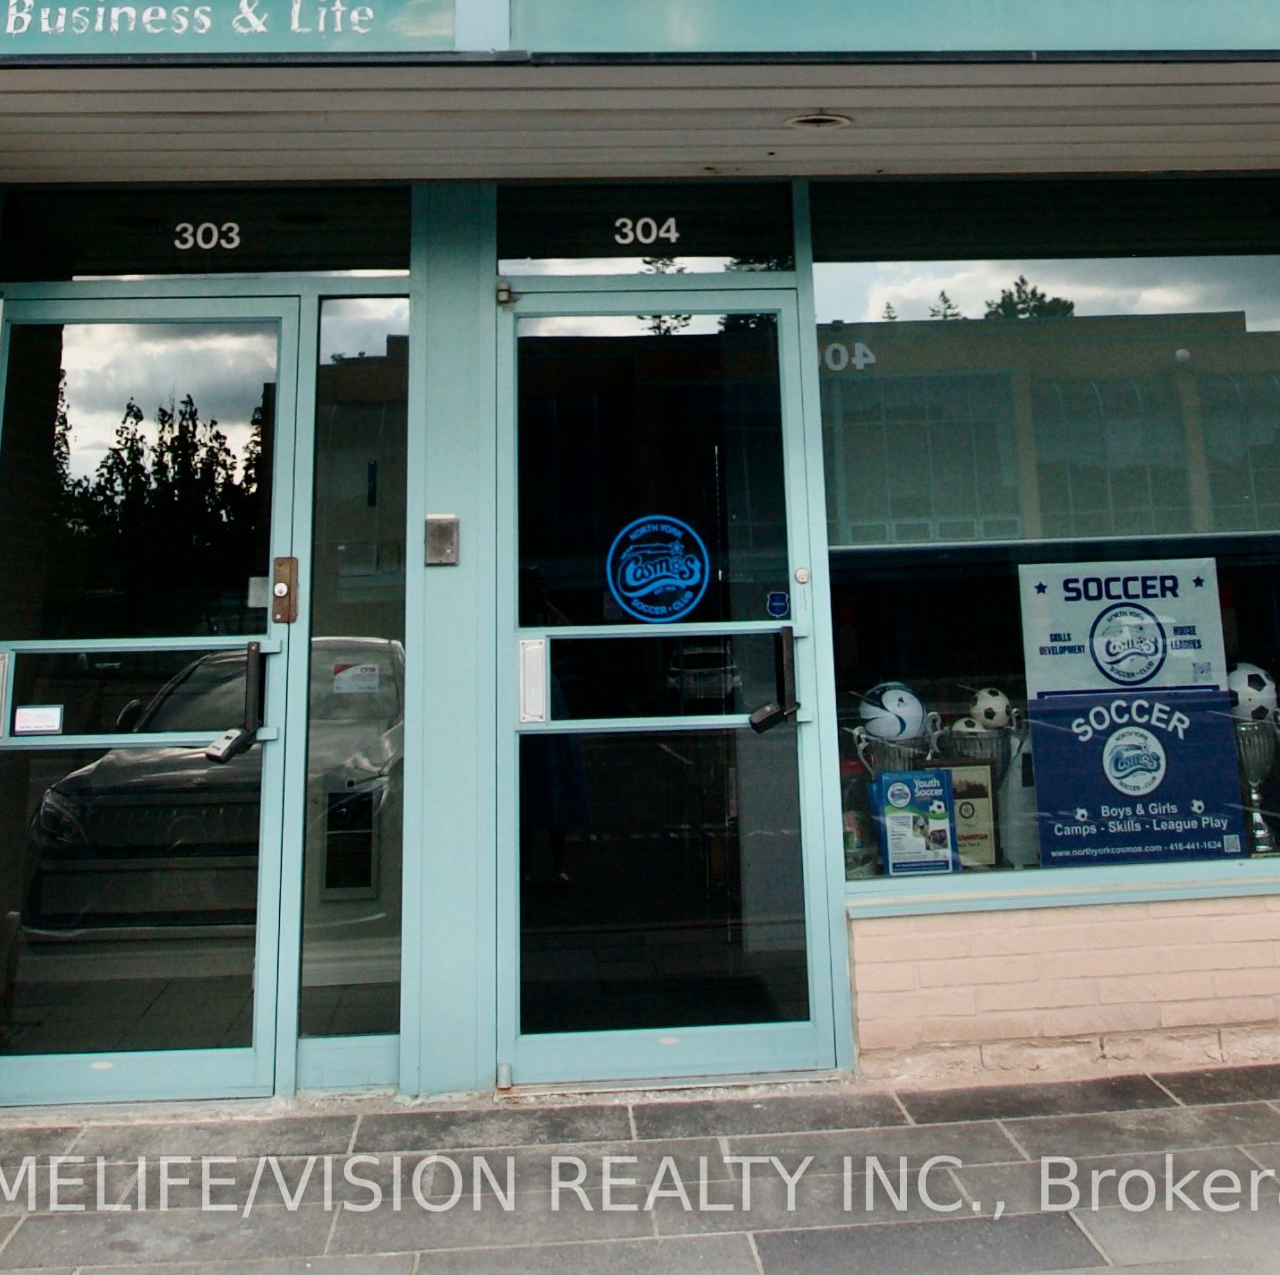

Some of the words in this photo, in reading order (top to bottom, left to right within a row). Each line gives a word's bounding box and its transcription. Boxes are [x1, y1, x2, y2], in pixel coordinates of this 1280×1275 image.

[174, 221, 241, 251] 303
[614, 216, 680, 245] 304
[629, 524, 660, 540] NORTH
[661, 524, 684, 540] YORK
[1062, 575, 1179, 602] SOCCER
[631, 598, 667, 615] SOCCER
[673, 590, 694, 612] CLUB
[1049, 633, 1072, 642] SKILLS
[1039, 645, 1086, 655] DEVELOPMENT
[1071, 699, 1190, 742] SOCCER
[914, 778, 940, 788] Youth
[914, 789, 944, 797] Soccer
[1100, 805, 1132, 820] Boys
[1135, 804, 1145, 815] &
[1148, 802, 1178, 815] Girls
[1054, 823, 1097, 838] Camps
[1108, 820, 1141, 833] Skills
[1152, 818, 1198, 832] League
[1201, 816, 1229, 829] Play
